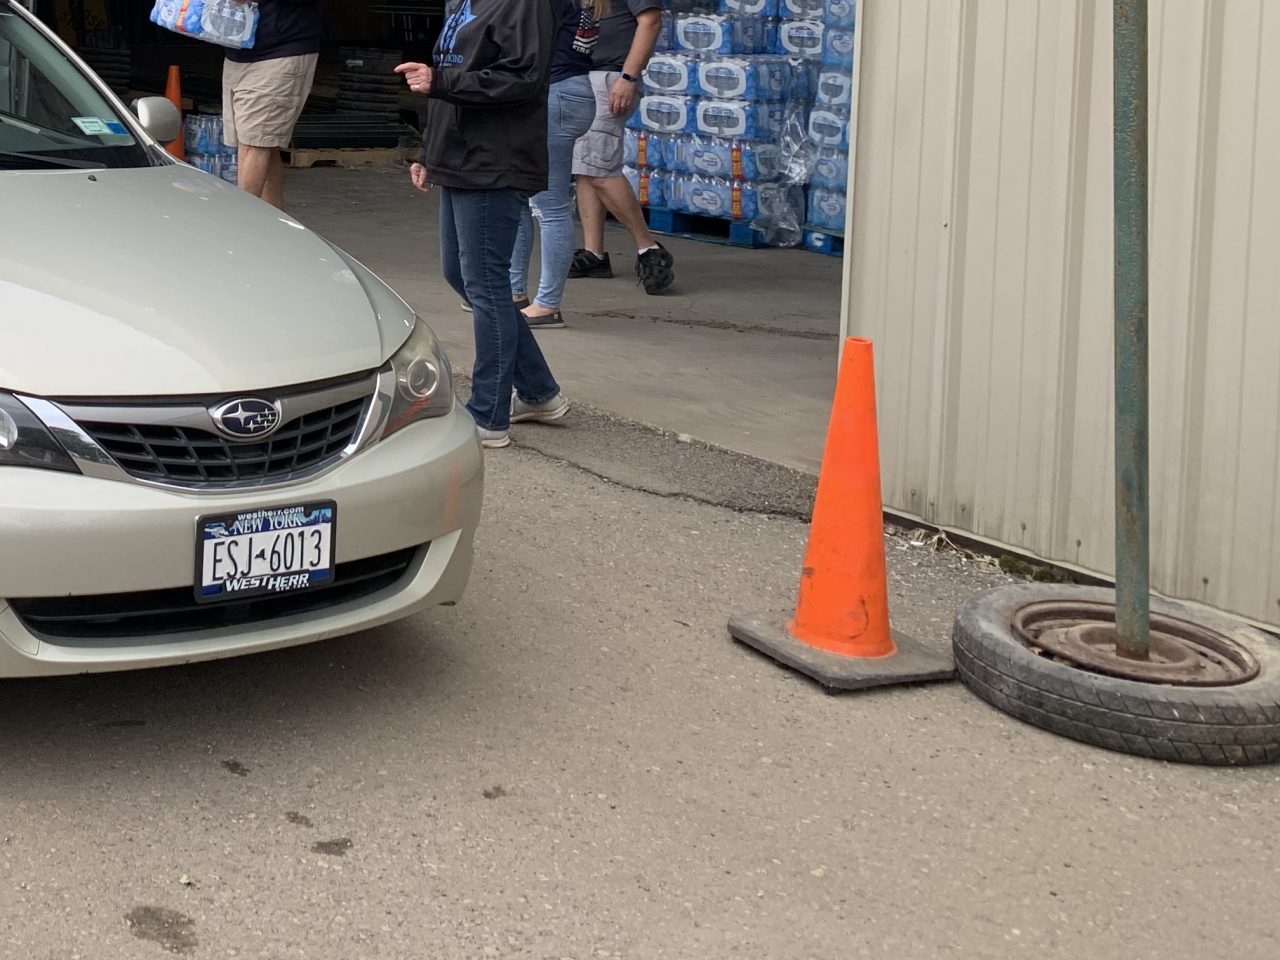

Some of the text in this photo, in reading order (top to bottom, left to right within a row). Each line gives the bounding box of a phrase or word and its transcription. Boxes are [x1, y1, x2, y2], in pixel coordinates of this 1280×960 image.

[233, 512, 303, 535] NEW YORK
[237, 505, 305, 520] westherr.com
[212, 529, 322, 582] ESJ 6013
